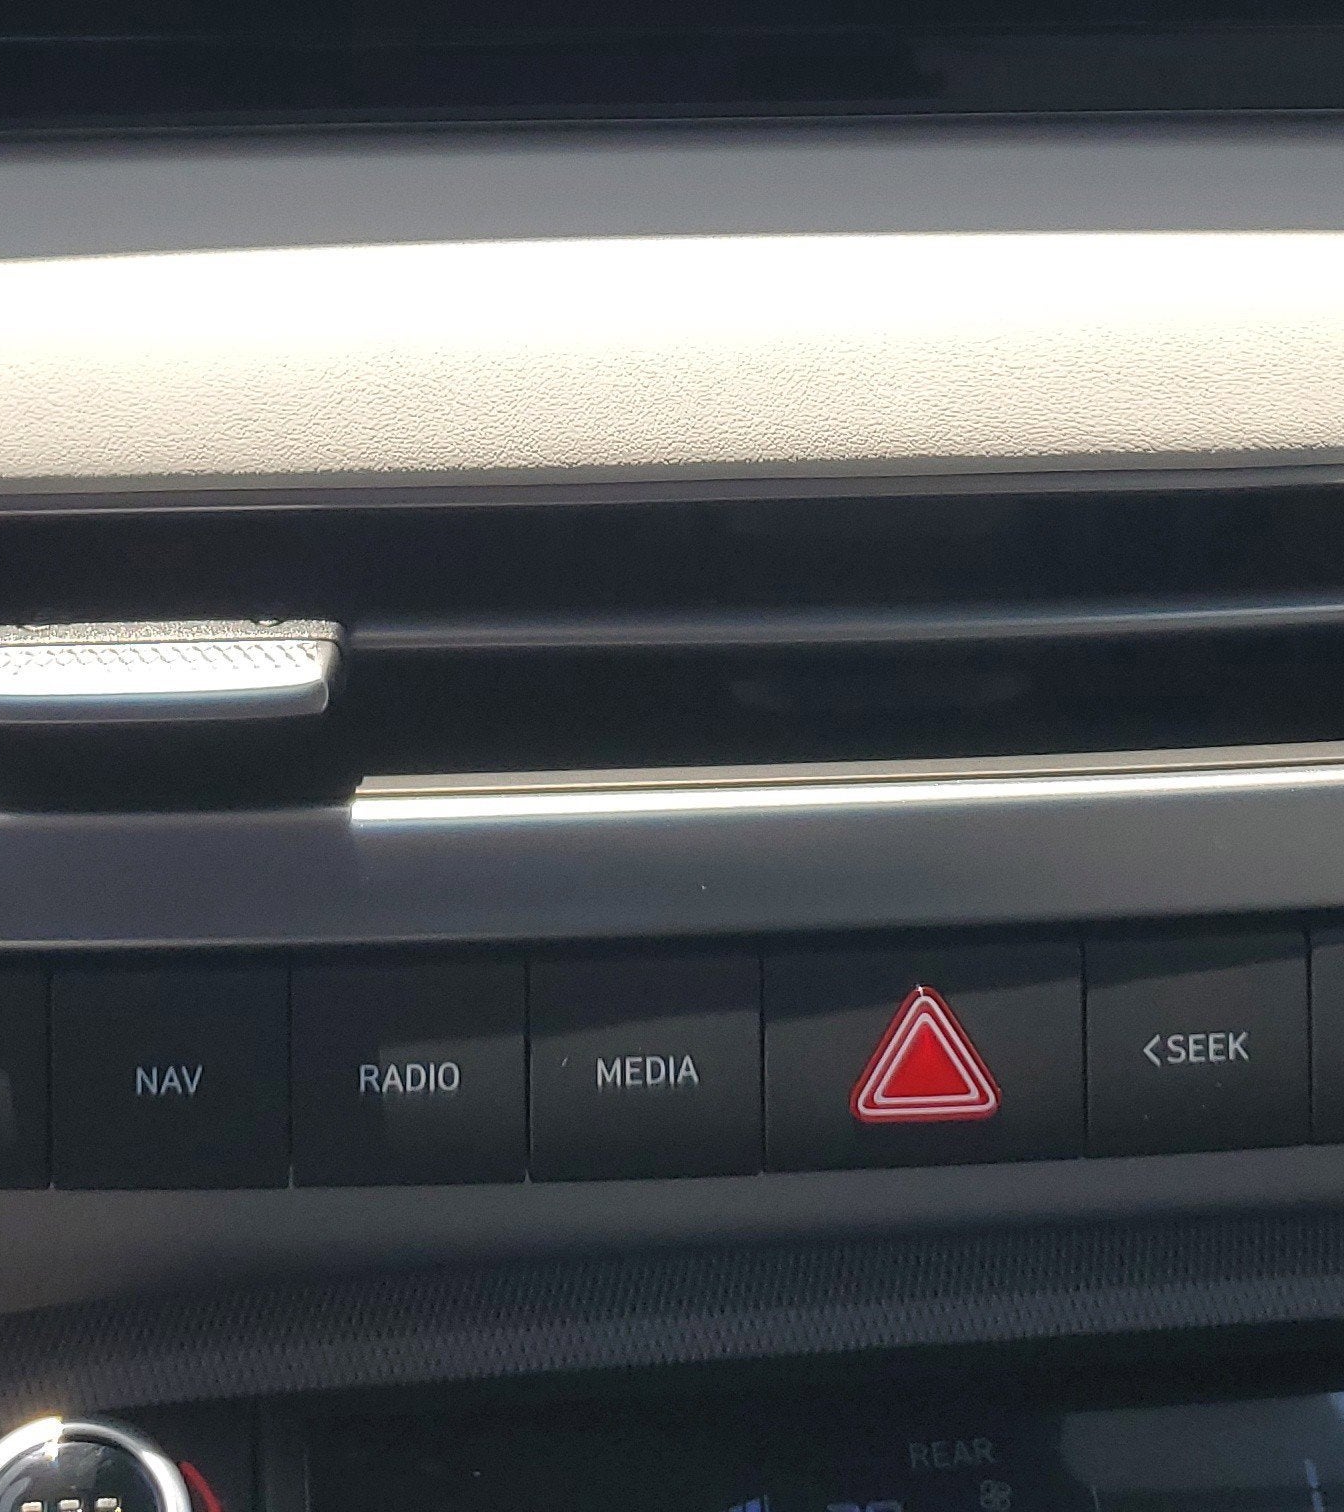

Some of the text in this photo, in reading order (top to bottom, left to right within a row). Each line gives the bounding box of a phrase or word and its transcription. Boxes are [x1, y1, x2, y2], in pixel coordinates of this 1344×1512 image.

[135, 1065, 204, 1097] NAV
[358, 1061, 461, 1094] RADIO
[596, 1053, 700, 1090] MEDIA
[909, 1437, 996, 1471] REAR
